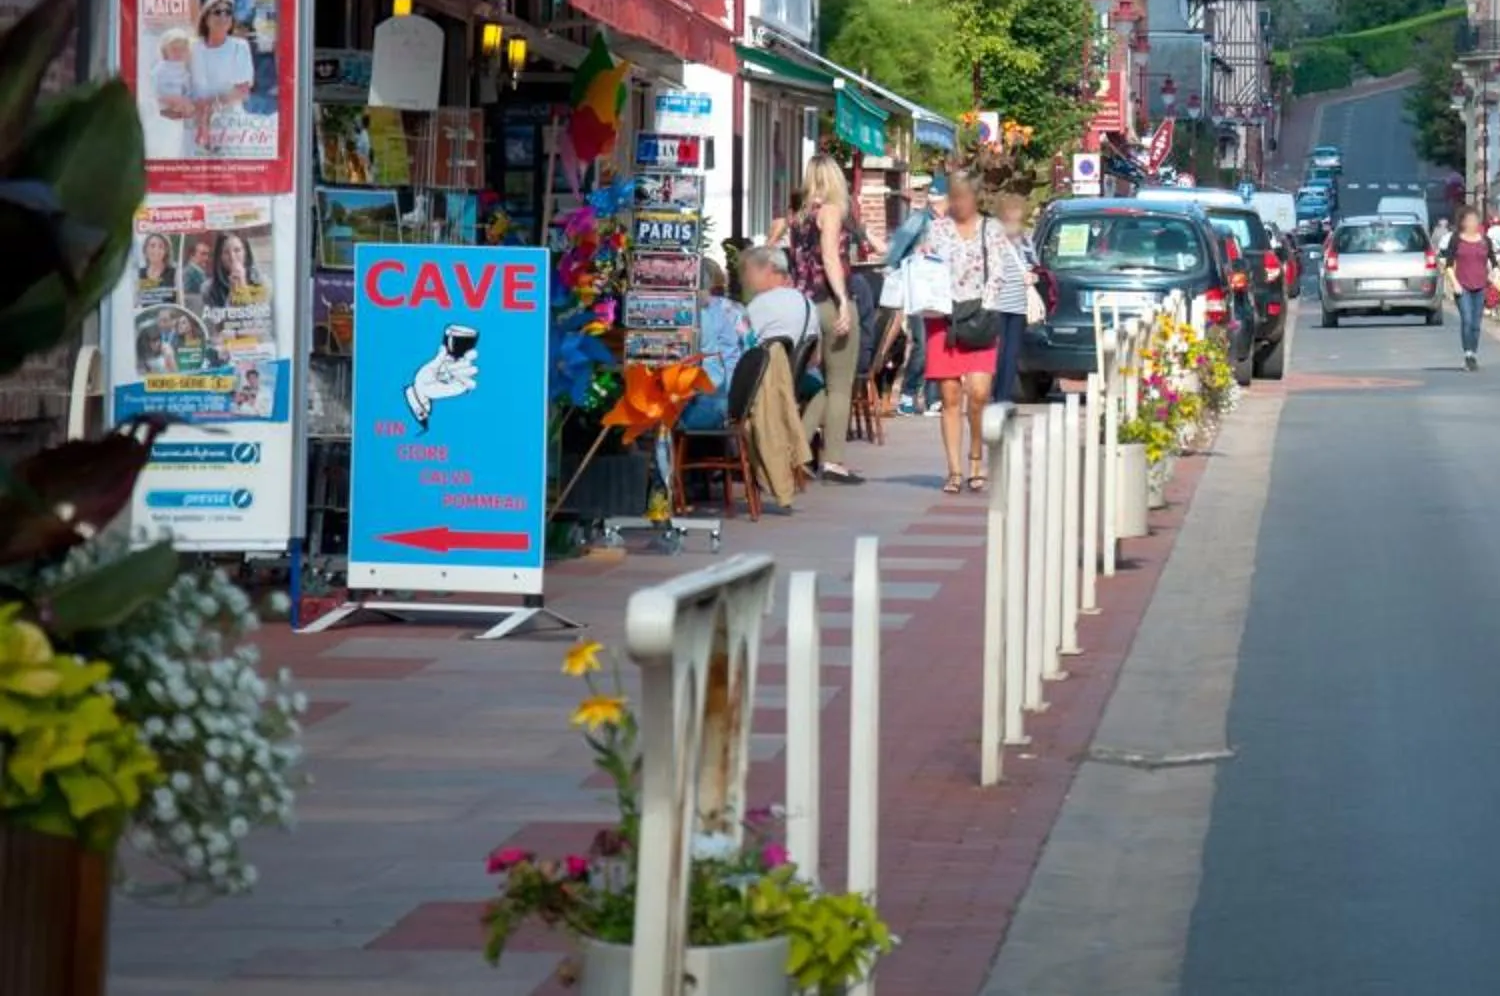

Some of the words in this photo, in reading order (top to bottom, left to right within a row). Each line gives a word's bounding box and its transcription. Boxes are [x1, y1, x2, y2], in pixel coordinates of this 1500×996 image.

[638, 222, 692, 241] PARIS
[364, 260, 537, 312] CAVE
[397, 444, 448, 461] CIDRE
